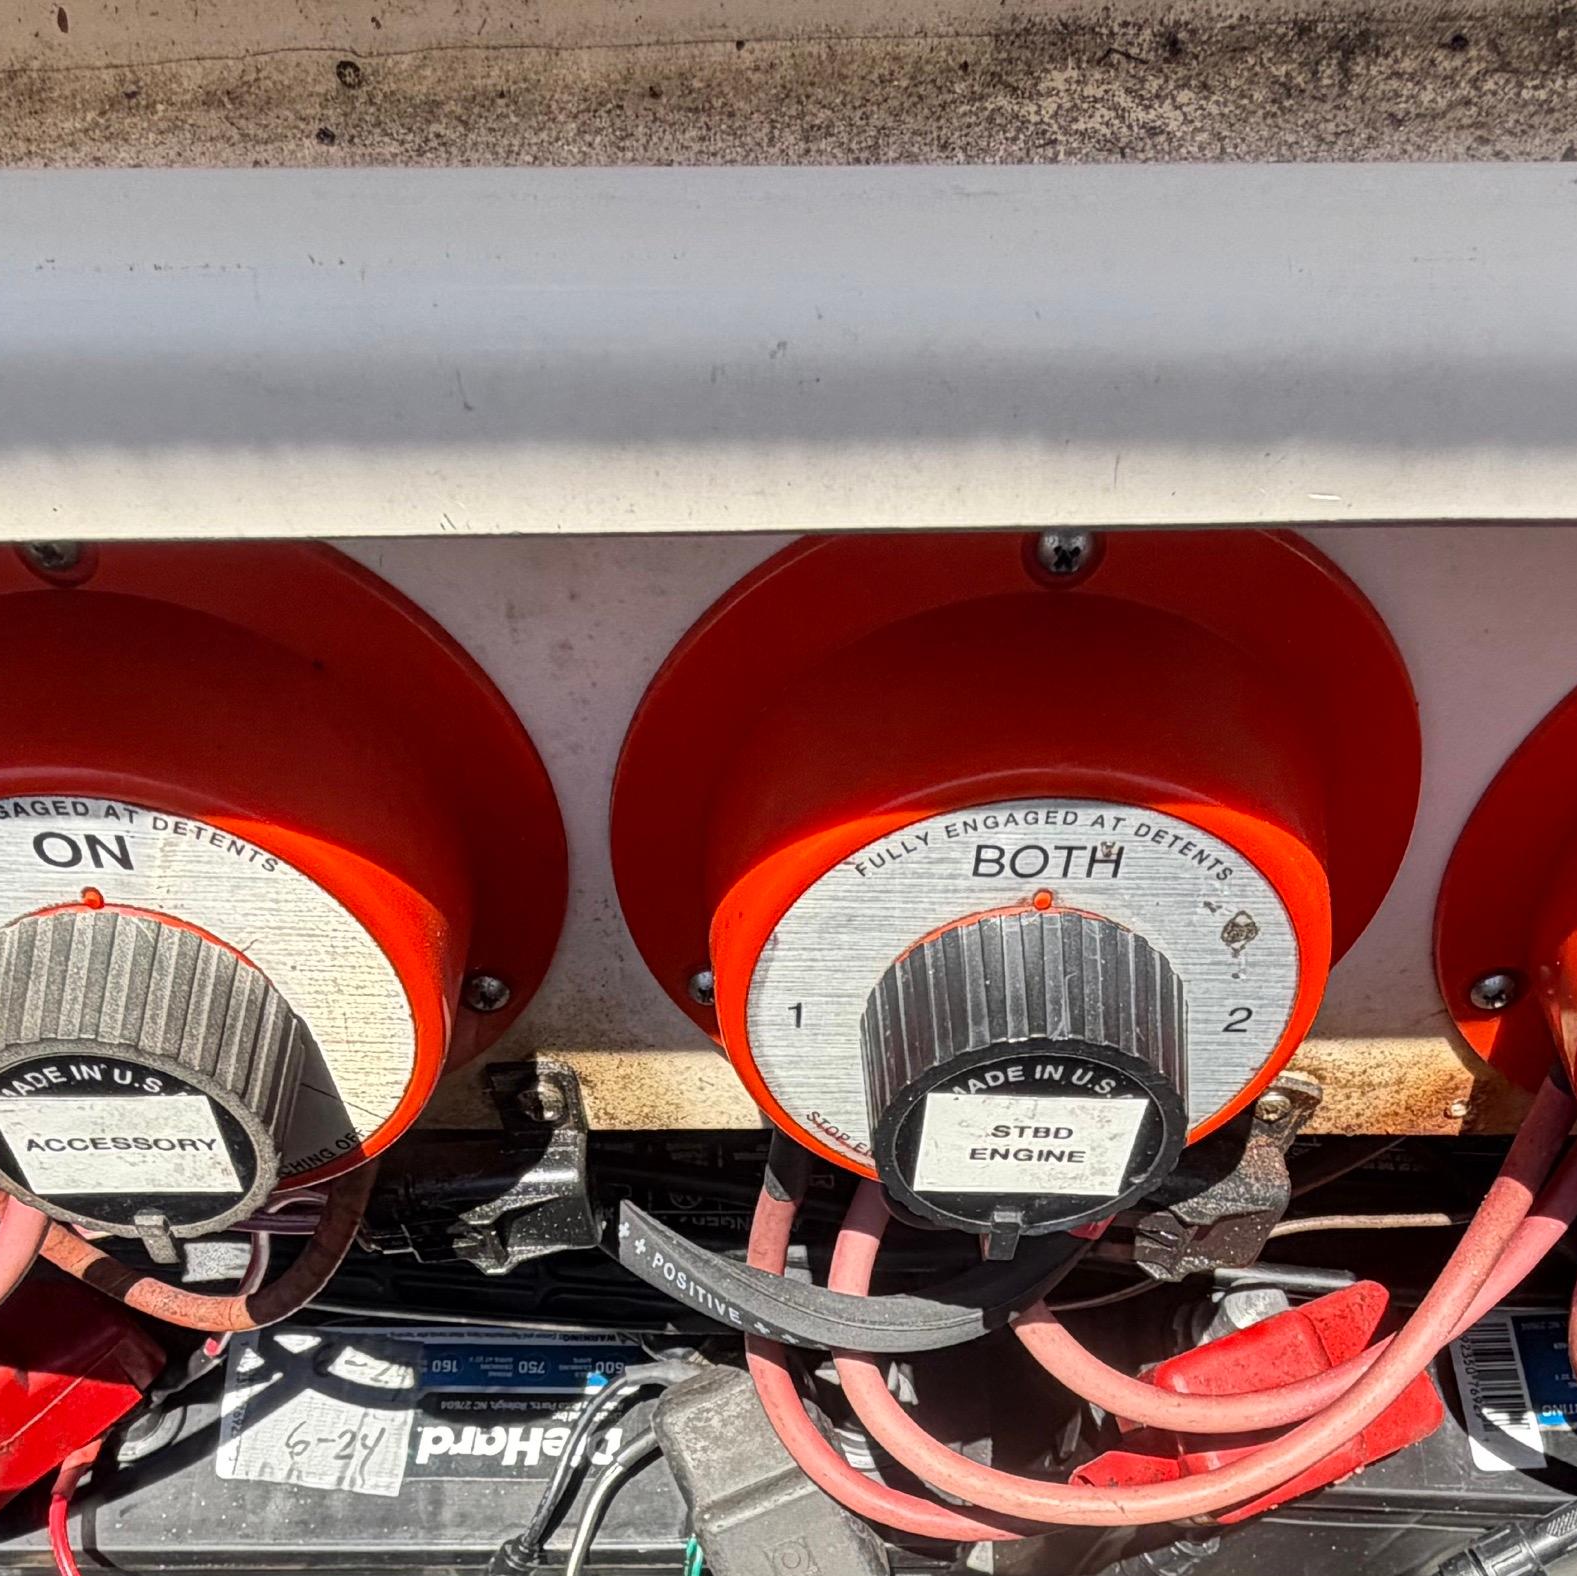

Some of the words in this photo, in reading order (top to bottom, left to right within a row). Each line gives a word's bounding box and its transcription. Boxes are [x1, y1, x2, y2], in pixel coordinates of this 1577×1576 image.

[32, 831, 135, 871] ON
[103, 805, 140, 825] AT
[151, 815, 281, 873] DETENTS
[853, 831, 931, 878] FULLY
[944, 810, 1079, 839] ENGAGED
[1090, 813, 1127, 832] AT
[1133, 821, 1234, 882] DETENTS
[971, 844, 1126, 879] BOTH
[787, 1002, 805, 1030] 1
[1222, 1005, 1254, 1034] 2
[70, 1064, 103, 1083] IN
[112, 1067, 189, 1098] U.S.
[1034, 1064, 1065, 1082] IN
[1071, 1066, 1134, 1099] U.S.
[25, 1136, 218, 1153] ACCESSORY
[805, 1110, 851, 1149] STOP
[990, 1124, 1075, 1141] STBD
[279, 1147, 336, 1177] CHING
[969, 1147, 1087, 1163] ENGINE
[650, 1251, 744, 1327] POSITIVE
[431, 1359, 459, 1373] 160
[517, 1360, 546, 1374] 750
[594, 1360, 625, 1375] 600
